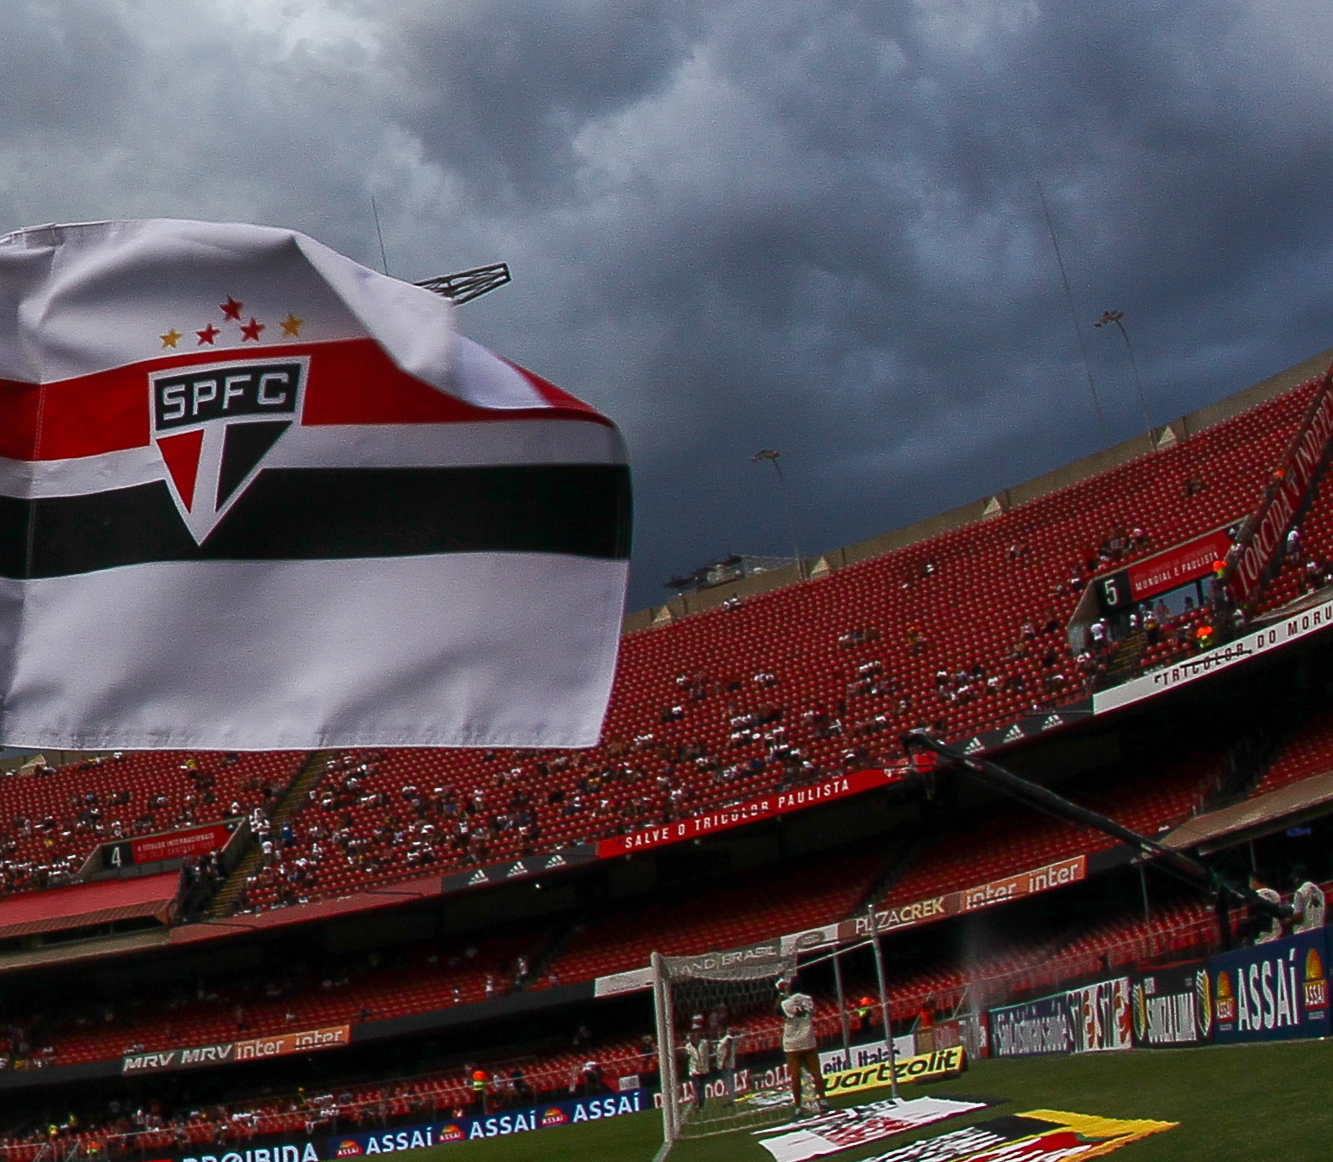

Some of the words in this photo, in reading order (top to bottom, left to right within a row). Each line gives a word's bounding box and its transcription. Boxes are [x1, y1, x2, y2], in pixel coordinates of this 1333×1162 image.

[163, 372, 290, 421] SPFC
[1104, 578, 1118, 605] 5
[1257, 630, 1276, 648] DO
[625, 827, 669, 848] SALVE
[678, 824, 686, 836] O
[694, 801, 770, 831] TRICOLOR
[778, 779, 849, 808] PAULISTA
[111, 846, 121, 867] 4
[1029, 863, 1079, 892] inter
[123, 1052, 175, 1072] MRV
[181, 1044, 233, 1064] MRV
[237, 1040, 286, 1060] inter
[824, 1051, 958, 1092] uartzolit
[182, 1142, 319, 1162] IBIDA
